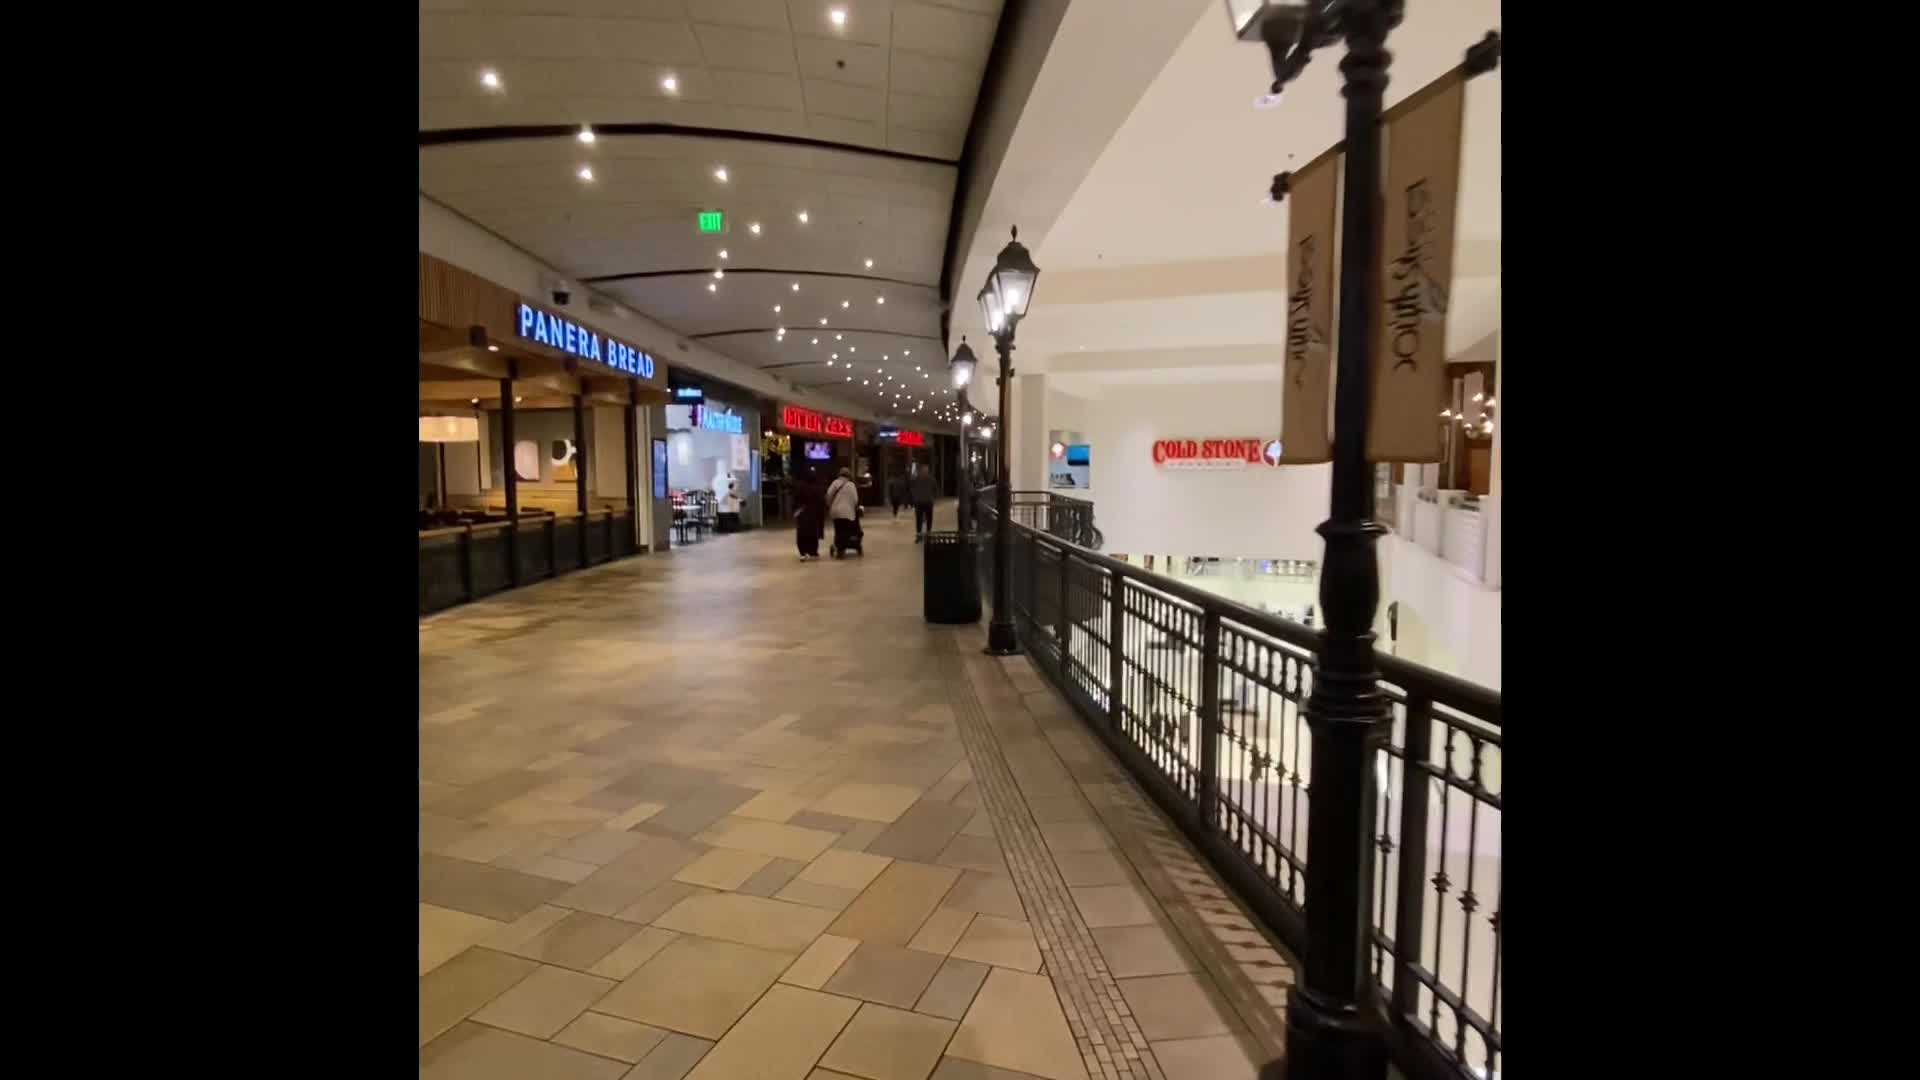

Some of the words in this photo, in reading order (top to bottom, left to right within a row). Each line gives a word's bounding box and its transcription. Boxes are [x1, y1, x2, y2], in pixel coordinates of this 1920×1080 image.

[699, 212, 722, 232] EXIT
[519, 303, 602, 362] PANERA
[607, 338, 654, 379] BREAD
[1153, 440, 1198, 463] COLD
[1201, 439, 1261, 463] STONE
